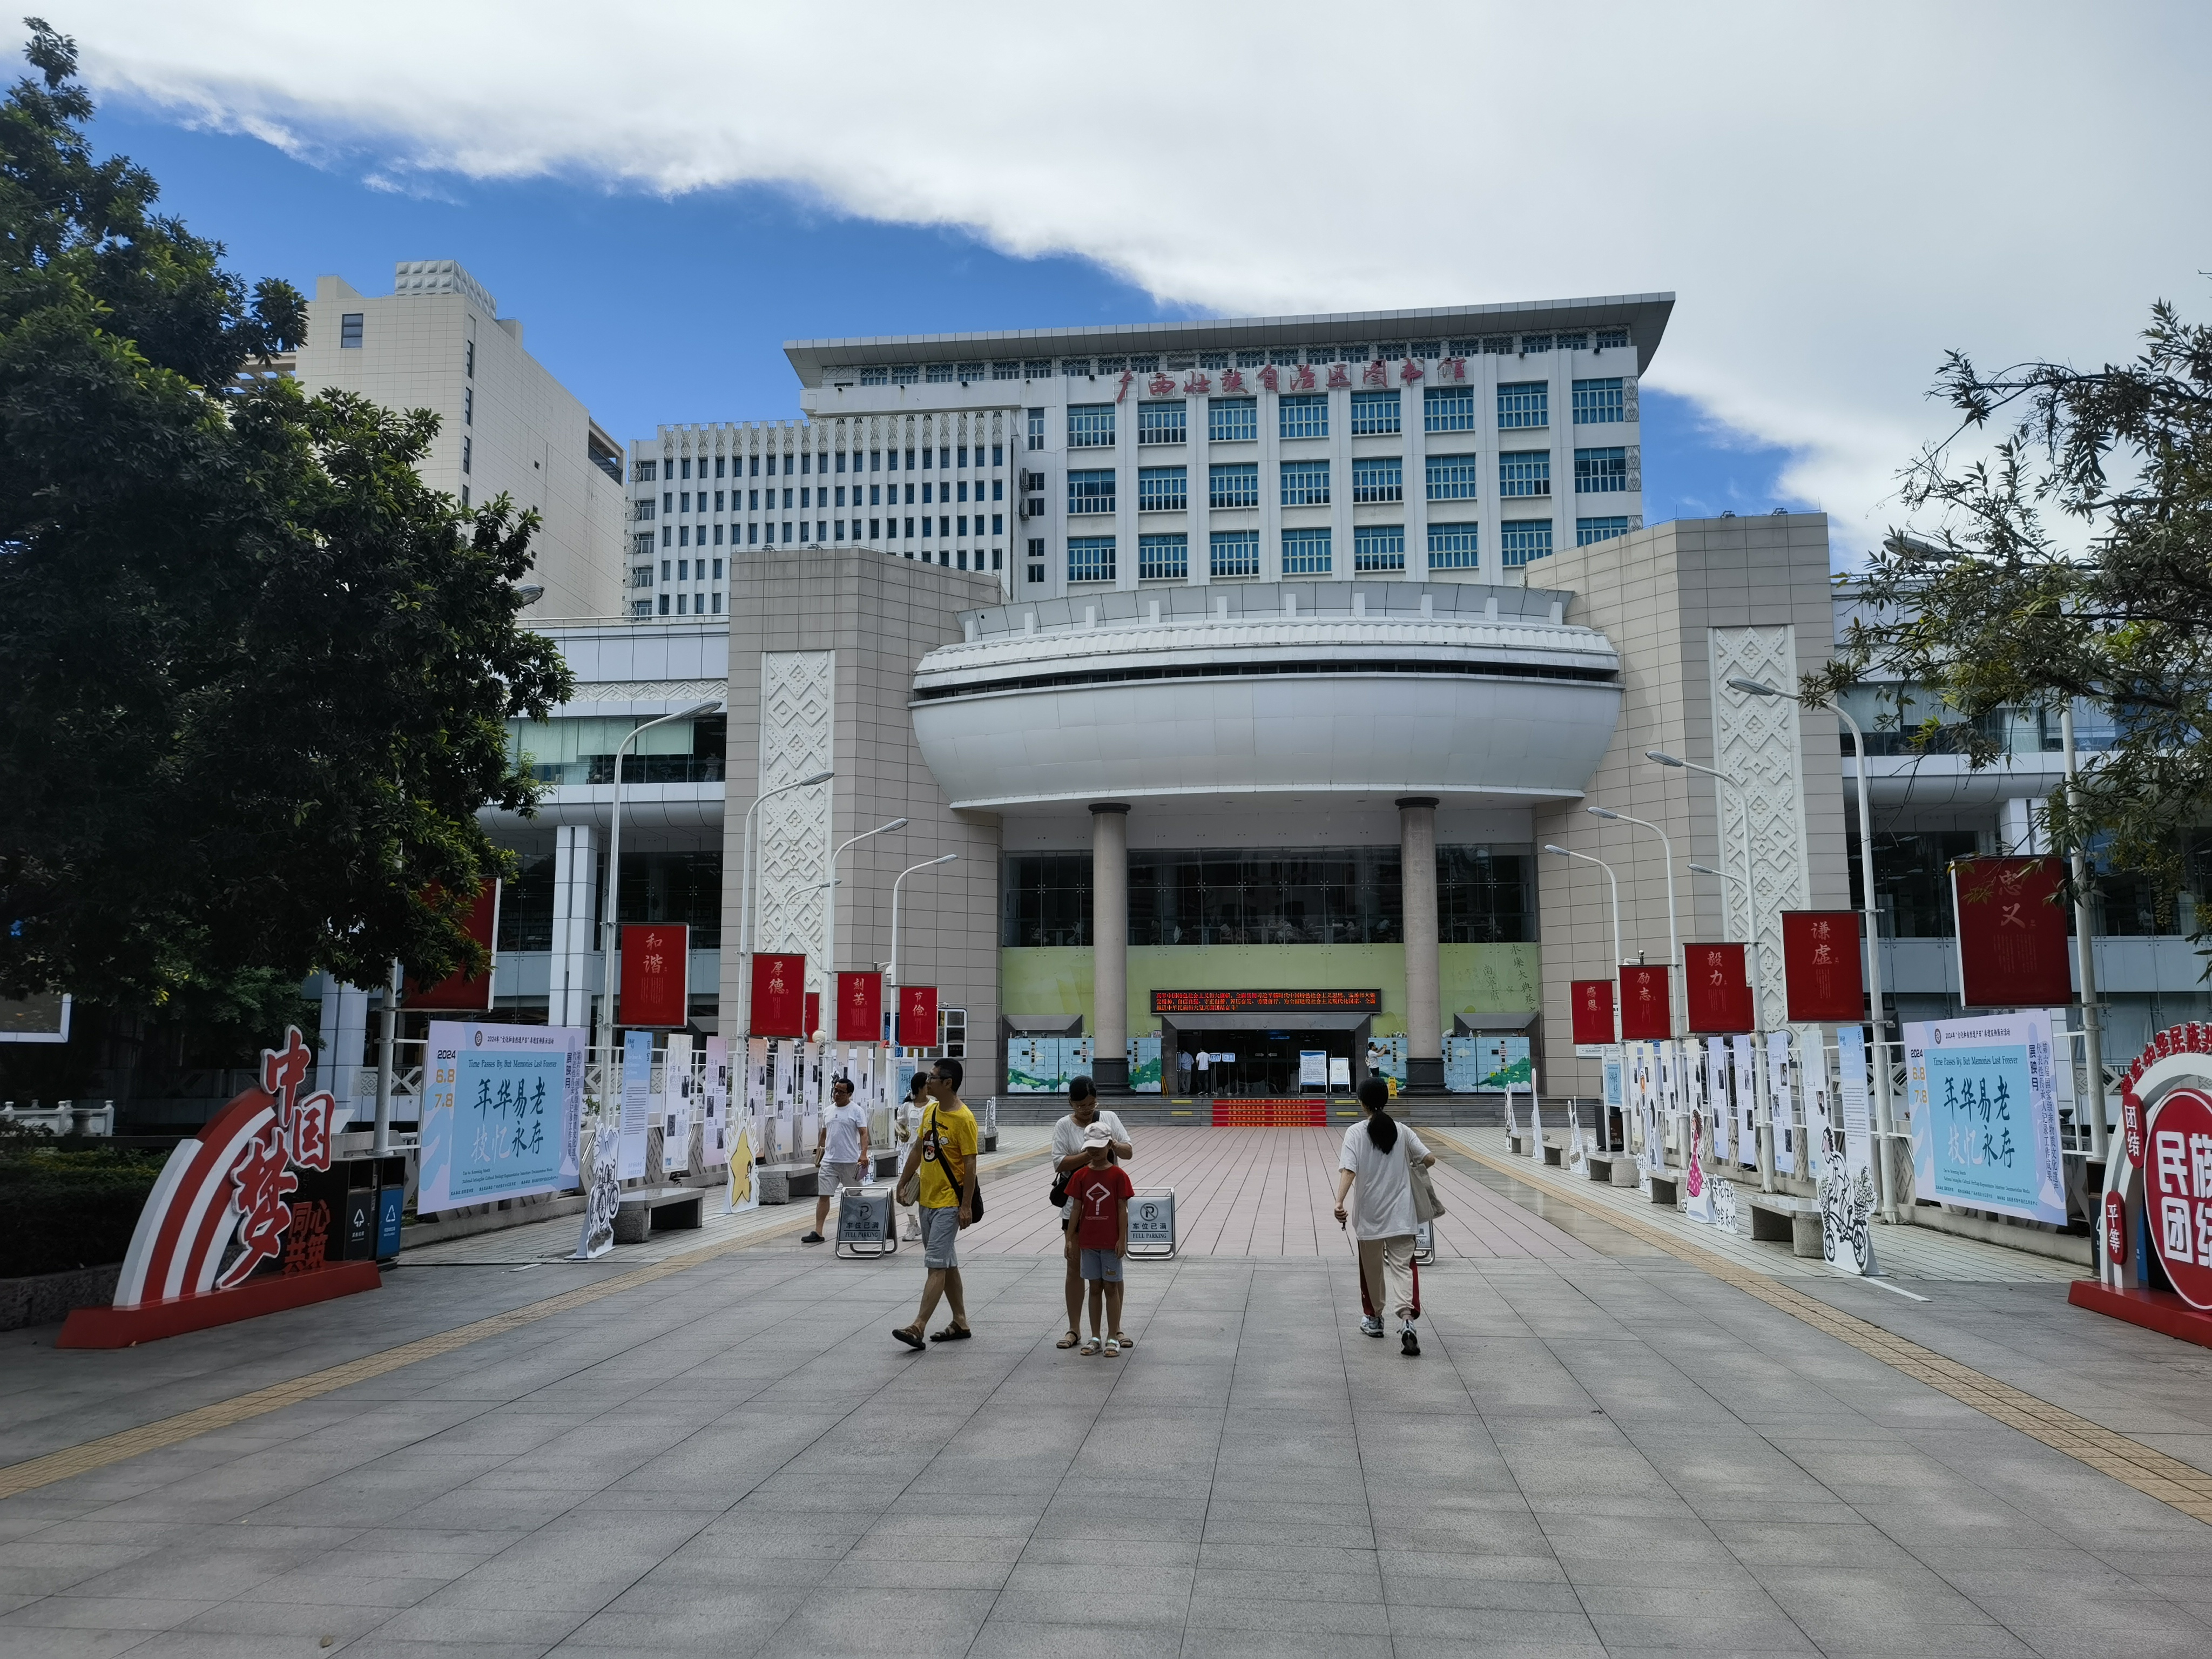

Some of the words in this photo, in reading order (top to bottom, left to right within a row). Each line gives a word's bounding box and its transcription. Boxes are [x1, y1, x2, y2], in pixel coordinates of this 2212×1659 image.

[643, 933, 663, 974] 和谐
[1811, 921, 1832, 965] 谦虚
[768, 961, 784, 995] 厚德
[1707, 951, 1723, 986] 毅力
[853, 977, 865, 1006] 刻苦
[1587, 986, 1598, 1011] 感恩
[1637, 972, 1651, 1002] 励志
[912, 992, 924, 1017] 节俭
[437, 1050, 456, 1060] 2024
[468, 1059, 480, 1068] Time
[481, 1059, 495, 1068] Passes
[513, 1060, 532, 1068] Memories
[1911, 1049, 1923, 1058] 2024
[1933, 1058, 1944, 1066] Time
[1944, 1057, 1955, 1065] Passes
[1972, 1055, 1991, 1065] Memories
[1992, 1055, 2001, 1064] Last
[2002, 1055, 2018, 1064] Forever
[2029, 1044, 2039, 1091] 展映月
[436, 1069, 455, 1083] 6.8
[1913, 1067, 1925, 1081] 6.8
[435, 1093, 453, 1108] 7.8
[474, 1076, 547, 1122] 年华易老
[1914, 1089, 1927, 1103] 7.8
[1944, 1075, 2011, 1123] 年华易老
[2126, 1105, 2140, 1157] 团结
[217, 1025, 336, 1290] 中国梦
[2156, 1131, 2212, 1199] 民族
[288, 1199, 331, 1238] 同心
[2107, 1204, 2120, 1253] 平等
[281, 1233, 329, 1275] 共筑
